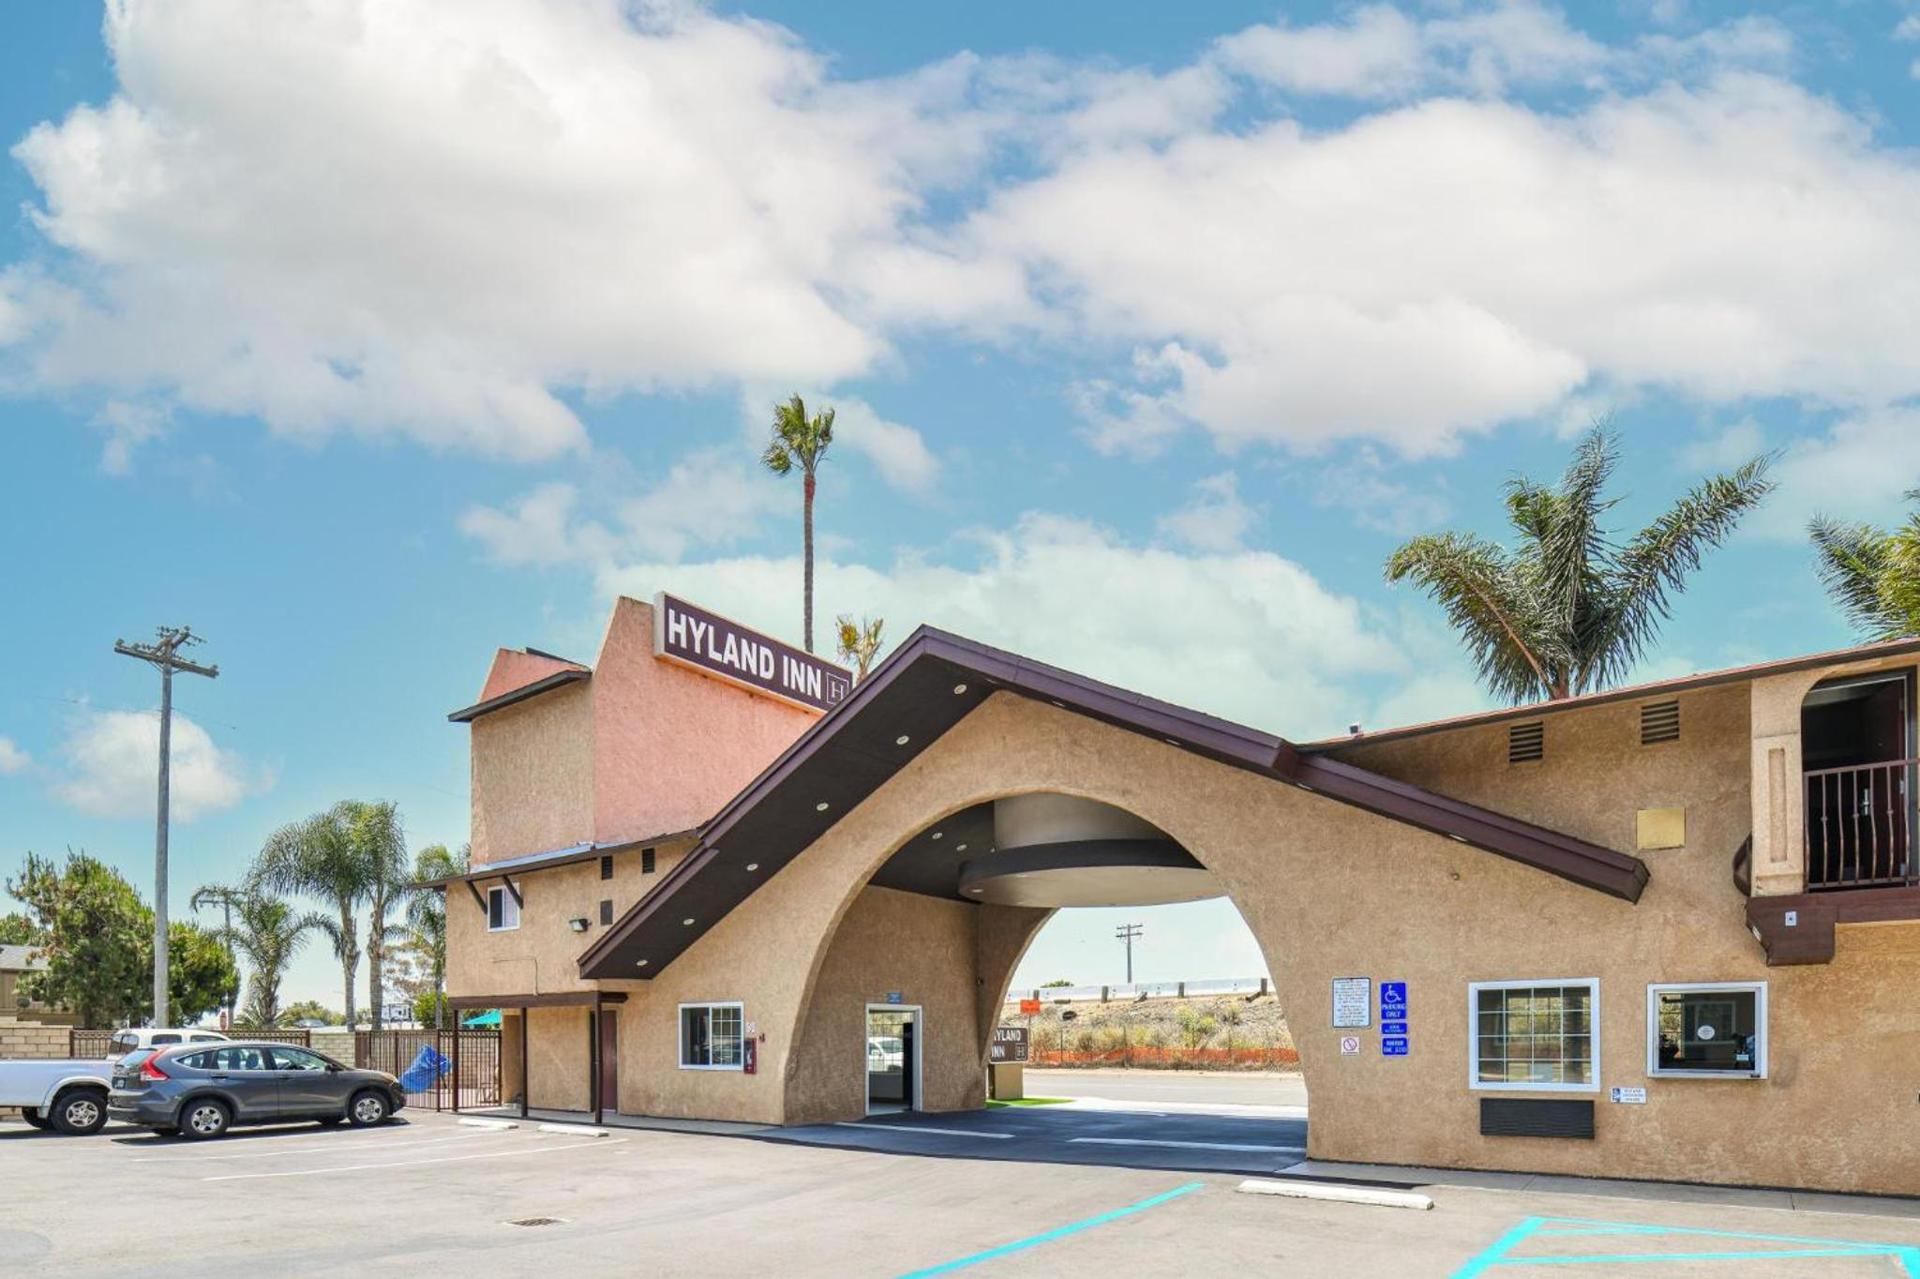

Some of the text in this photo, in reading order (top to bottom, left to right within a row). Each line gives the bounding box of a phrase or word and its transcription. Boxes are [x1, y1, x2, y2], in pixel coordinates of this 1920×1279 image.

[668, 608, 822, 700] HYLAND INN
[994, 1029, 1021, 1041] YLAND
